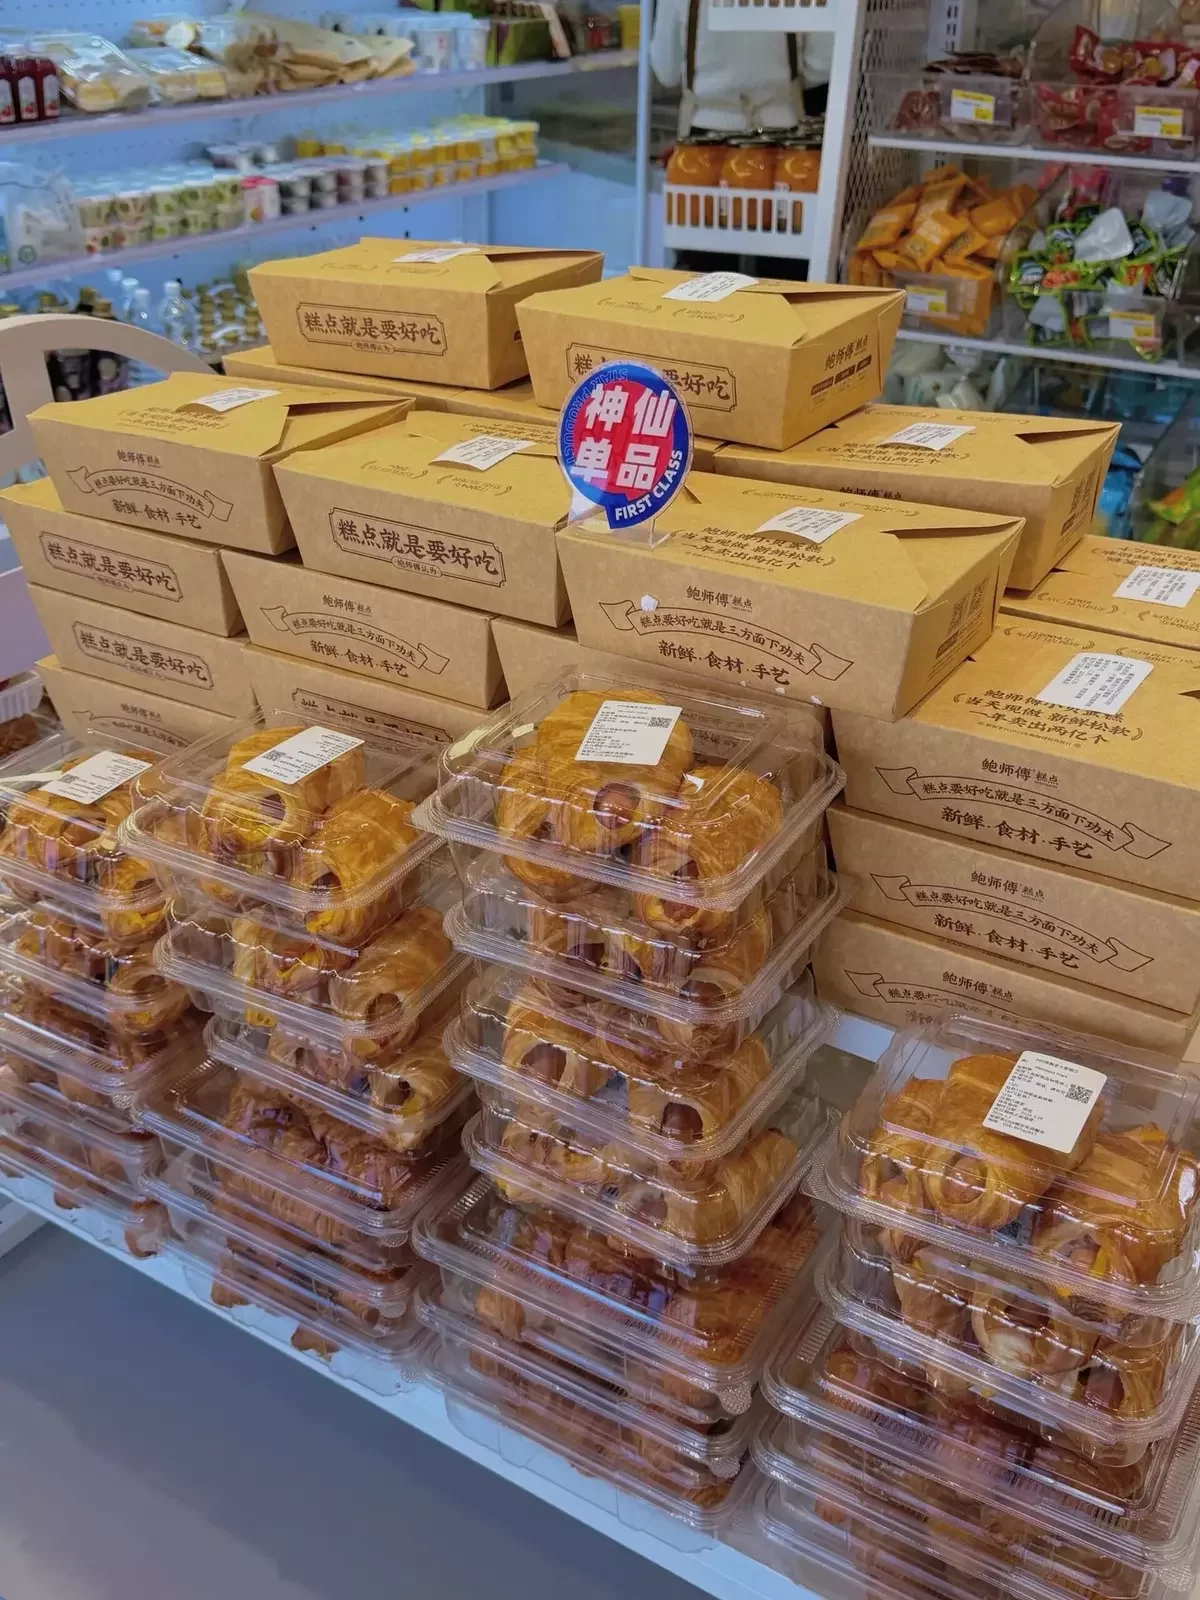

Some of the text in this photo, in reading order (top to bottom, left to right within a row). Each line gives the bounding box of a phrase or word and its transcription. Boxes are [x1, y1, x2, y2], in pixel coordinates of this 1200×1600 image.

[304, 311, 442, 347] 糕点就是要好吃
[585, 383, 677, 438] 神仙
[570, 436, 660, 490] 单品
[614, 449, 683, 521] FIRST CLASS
[47, 542, 176, 592] 糕点就是要好吃
[337, 518, 499, 576] 糕点就是要好吃
[79, 630, 208, 682] 糕点就是要好吃
[291, 617, 417, 662] 糕点要好吃就是三方面下功夫
[640, 613, 805, 666] 糕点要好吃就是三方面下功夫
[965, 696, 1042, 718] 当天现做
[1048, 712, 1131, 737] 新鲜松软
[968, 709, 1110, 745] 一年卖出两亿个
[922, 782, 1115, 842] 糕点要好吃就是三方面下功夫
[915, 889, 1099, 956] 糕点要好吃就是三方面下功夫
